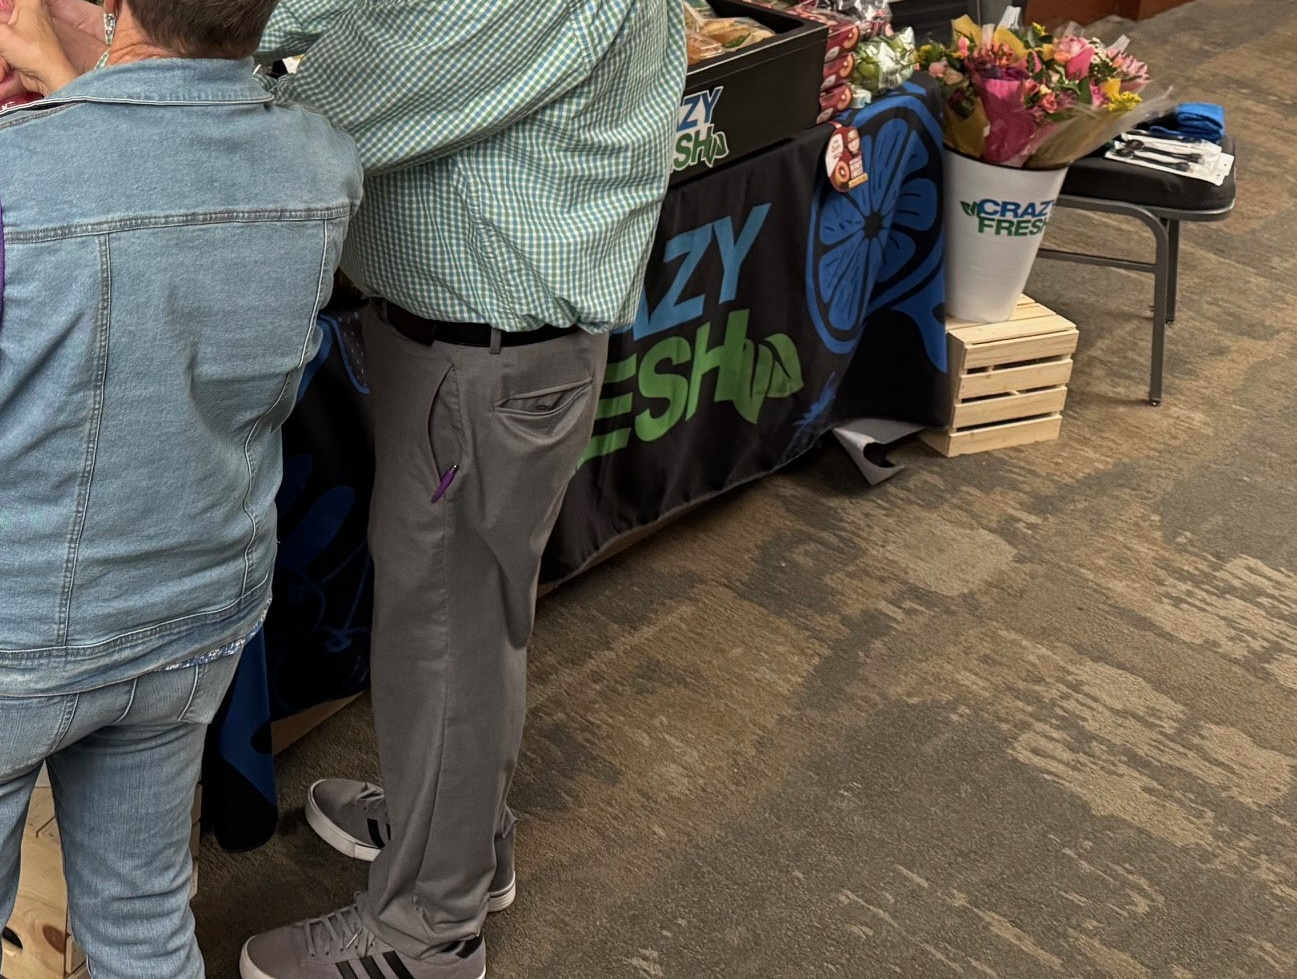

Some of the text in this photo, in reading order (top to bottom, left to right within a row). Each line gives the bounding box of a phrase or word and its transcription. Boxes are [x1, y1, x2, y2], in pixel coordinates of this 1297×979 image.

[977, 198, 1054, 219] CRAZ
[978, 217, 1046, 237] FRES
[577, 308, 751, 470] ESH
